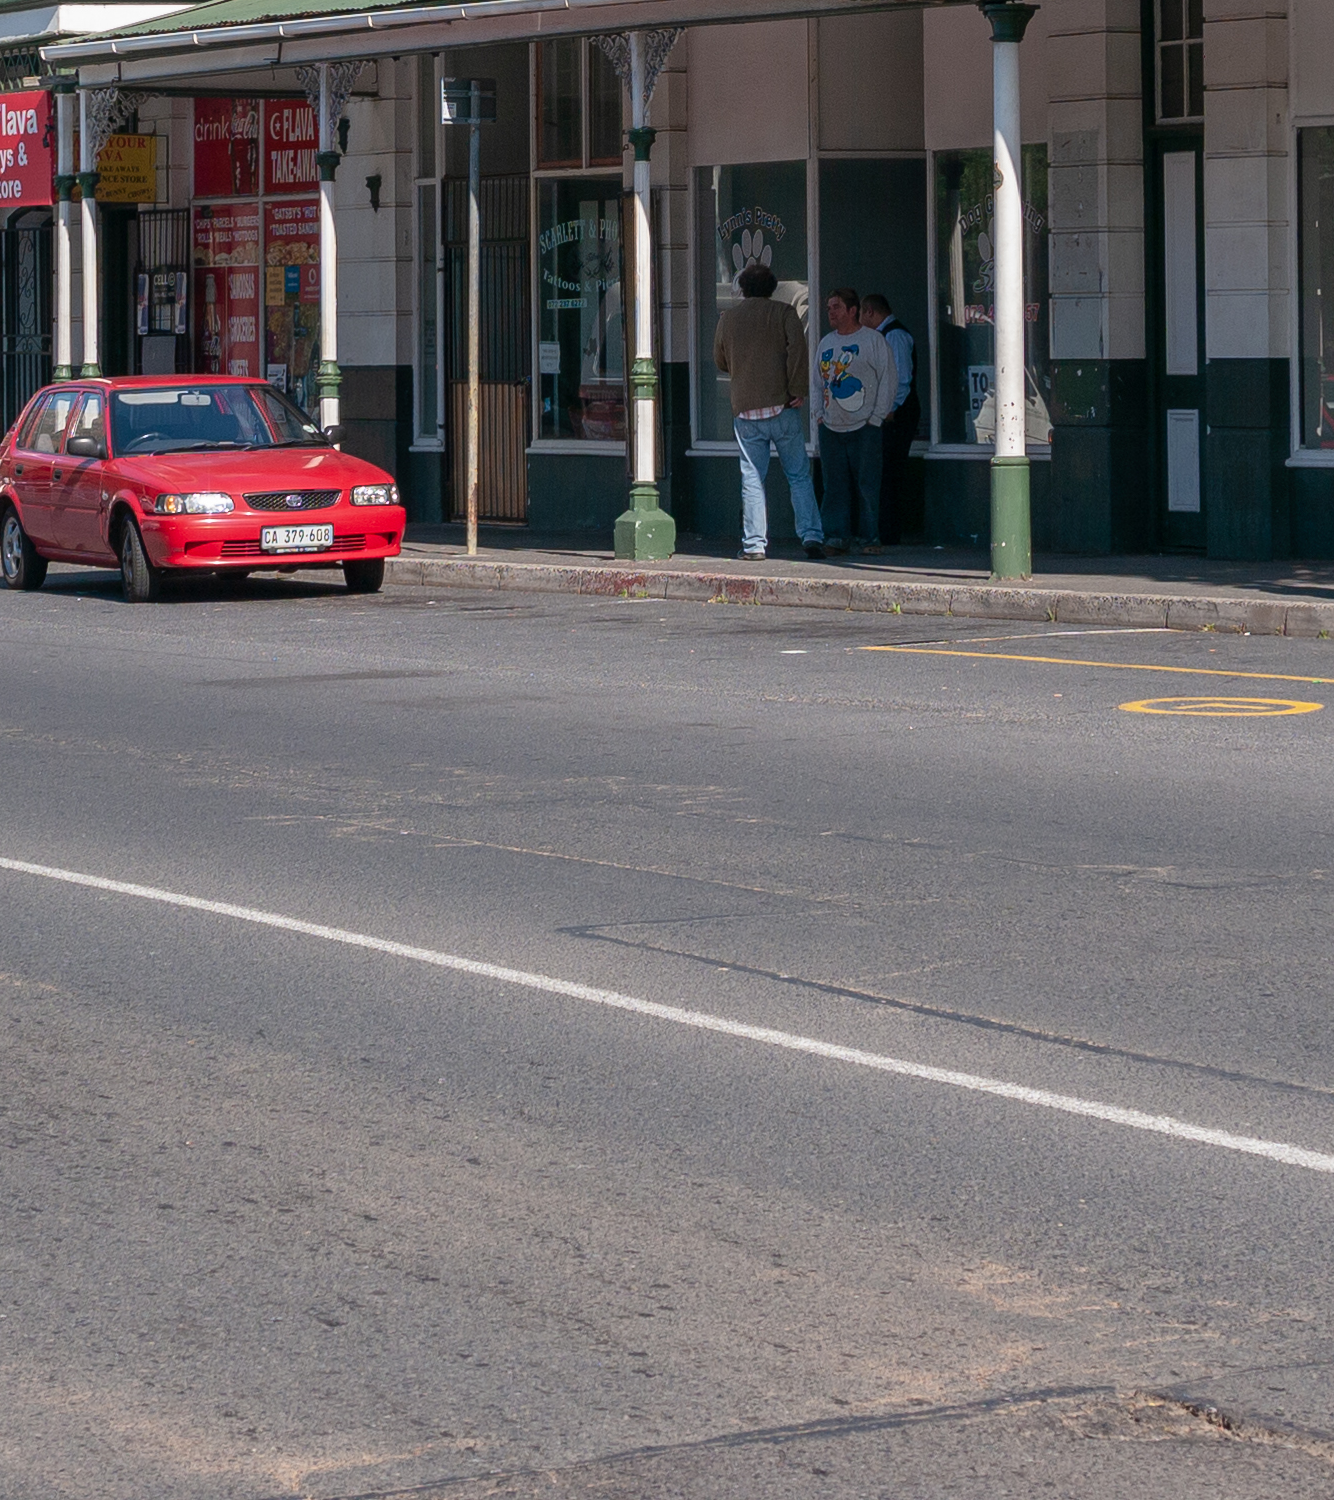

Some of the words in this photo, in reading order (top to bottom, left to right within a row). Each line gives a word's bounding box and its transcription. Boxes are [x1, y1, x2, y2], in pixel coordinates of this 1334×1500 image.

[194, 115, 230, 142] drink
[283, 107, 315, 142] FLAVA
[17, 142, 28, 167] &
[108, 136, 146, 148] YOUR
[120, 175, 148, 184] STORE
[717, 206, 752, 241] Lynn's
[754, 206, 787, 242] Pretty
[958, 203, 983, 236] Dog
[539, 219, 586, 255] SCARLETT
[588, 218, 597, 239] &
[542, 268, 581, 292] Tattoos
[584, 281, 592, 293] &
[964, 304, 985, 324] 072
[971, 372, 989, 393] TO
[264, 530, 278, 544] CA
[284, 528, 330, 544] 379-608
